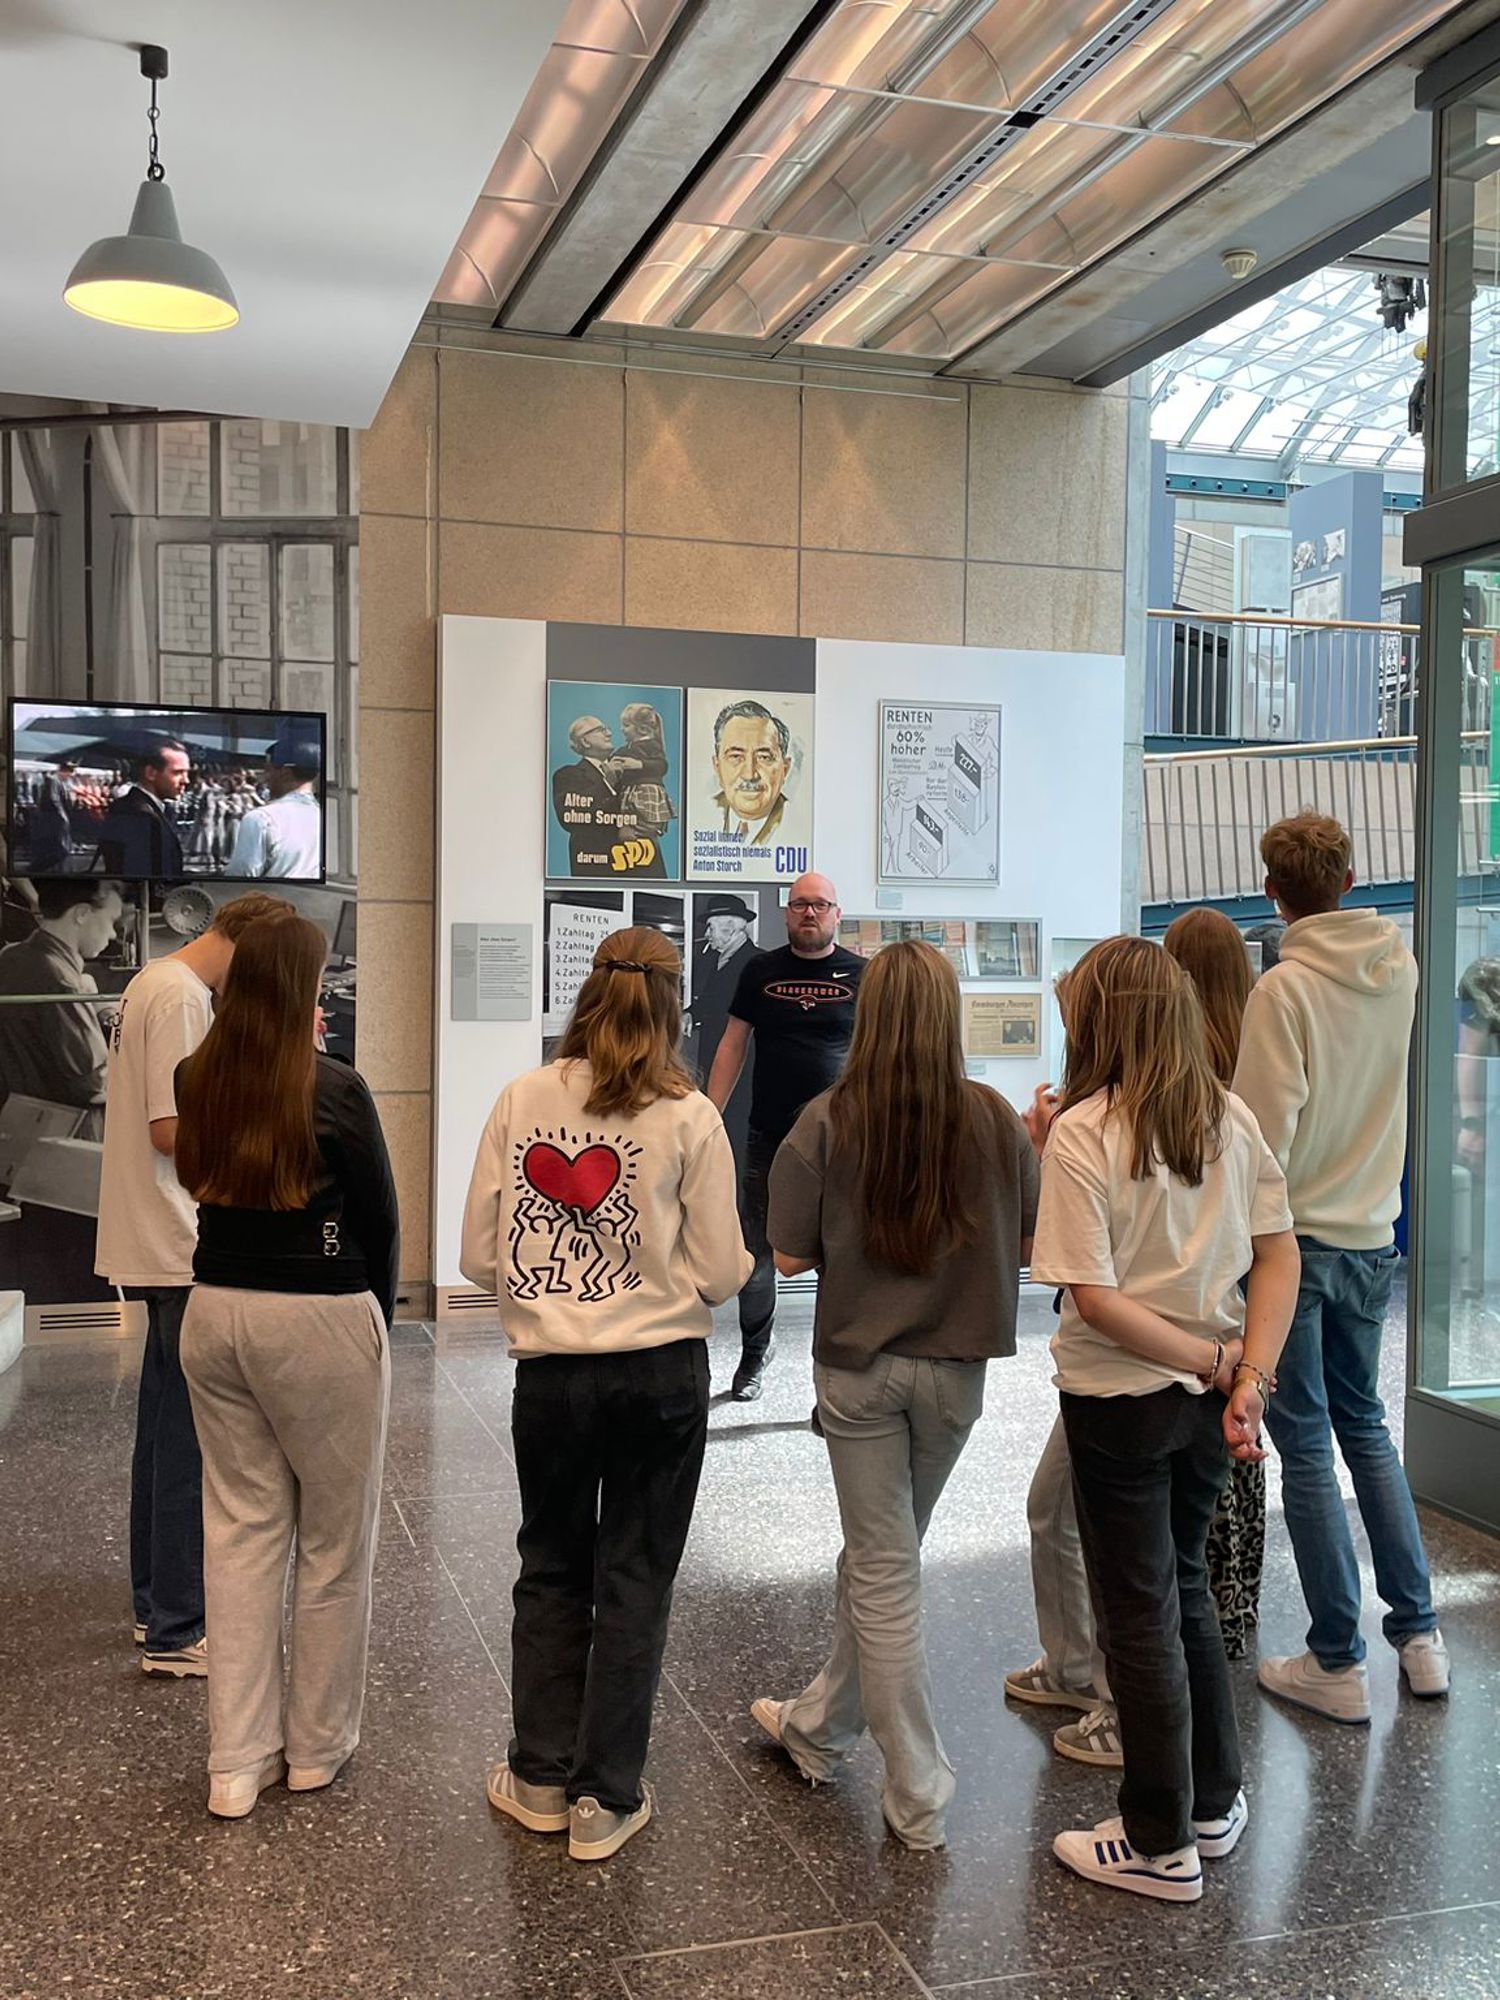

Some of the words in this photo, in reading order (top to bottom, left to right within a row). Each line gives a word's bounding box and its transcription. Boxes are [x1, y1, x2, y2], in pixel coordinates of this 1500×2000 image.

[887, 710, 932, 723] RENTEN
[896, 730, 925, 743] 60%
[564, 793, 593, 807] Alter
[563, 809, 591, 823] ohne
[596, 810, 637, 828] Sorgen
[694, 830, 716, 842] Sozial
[577, 851, 608, 864] darum
[611, 838, 655, 871] SPD
[693, 845, 741, 857] sozialistisch
[742, 847, 772, 858] niemals
[693, 859, 714, 871] Anton
[716, 860, 742, 872] Storch
[775, 846, 807, 873] CDU
[573, 913, 609, 924] RENTEN
